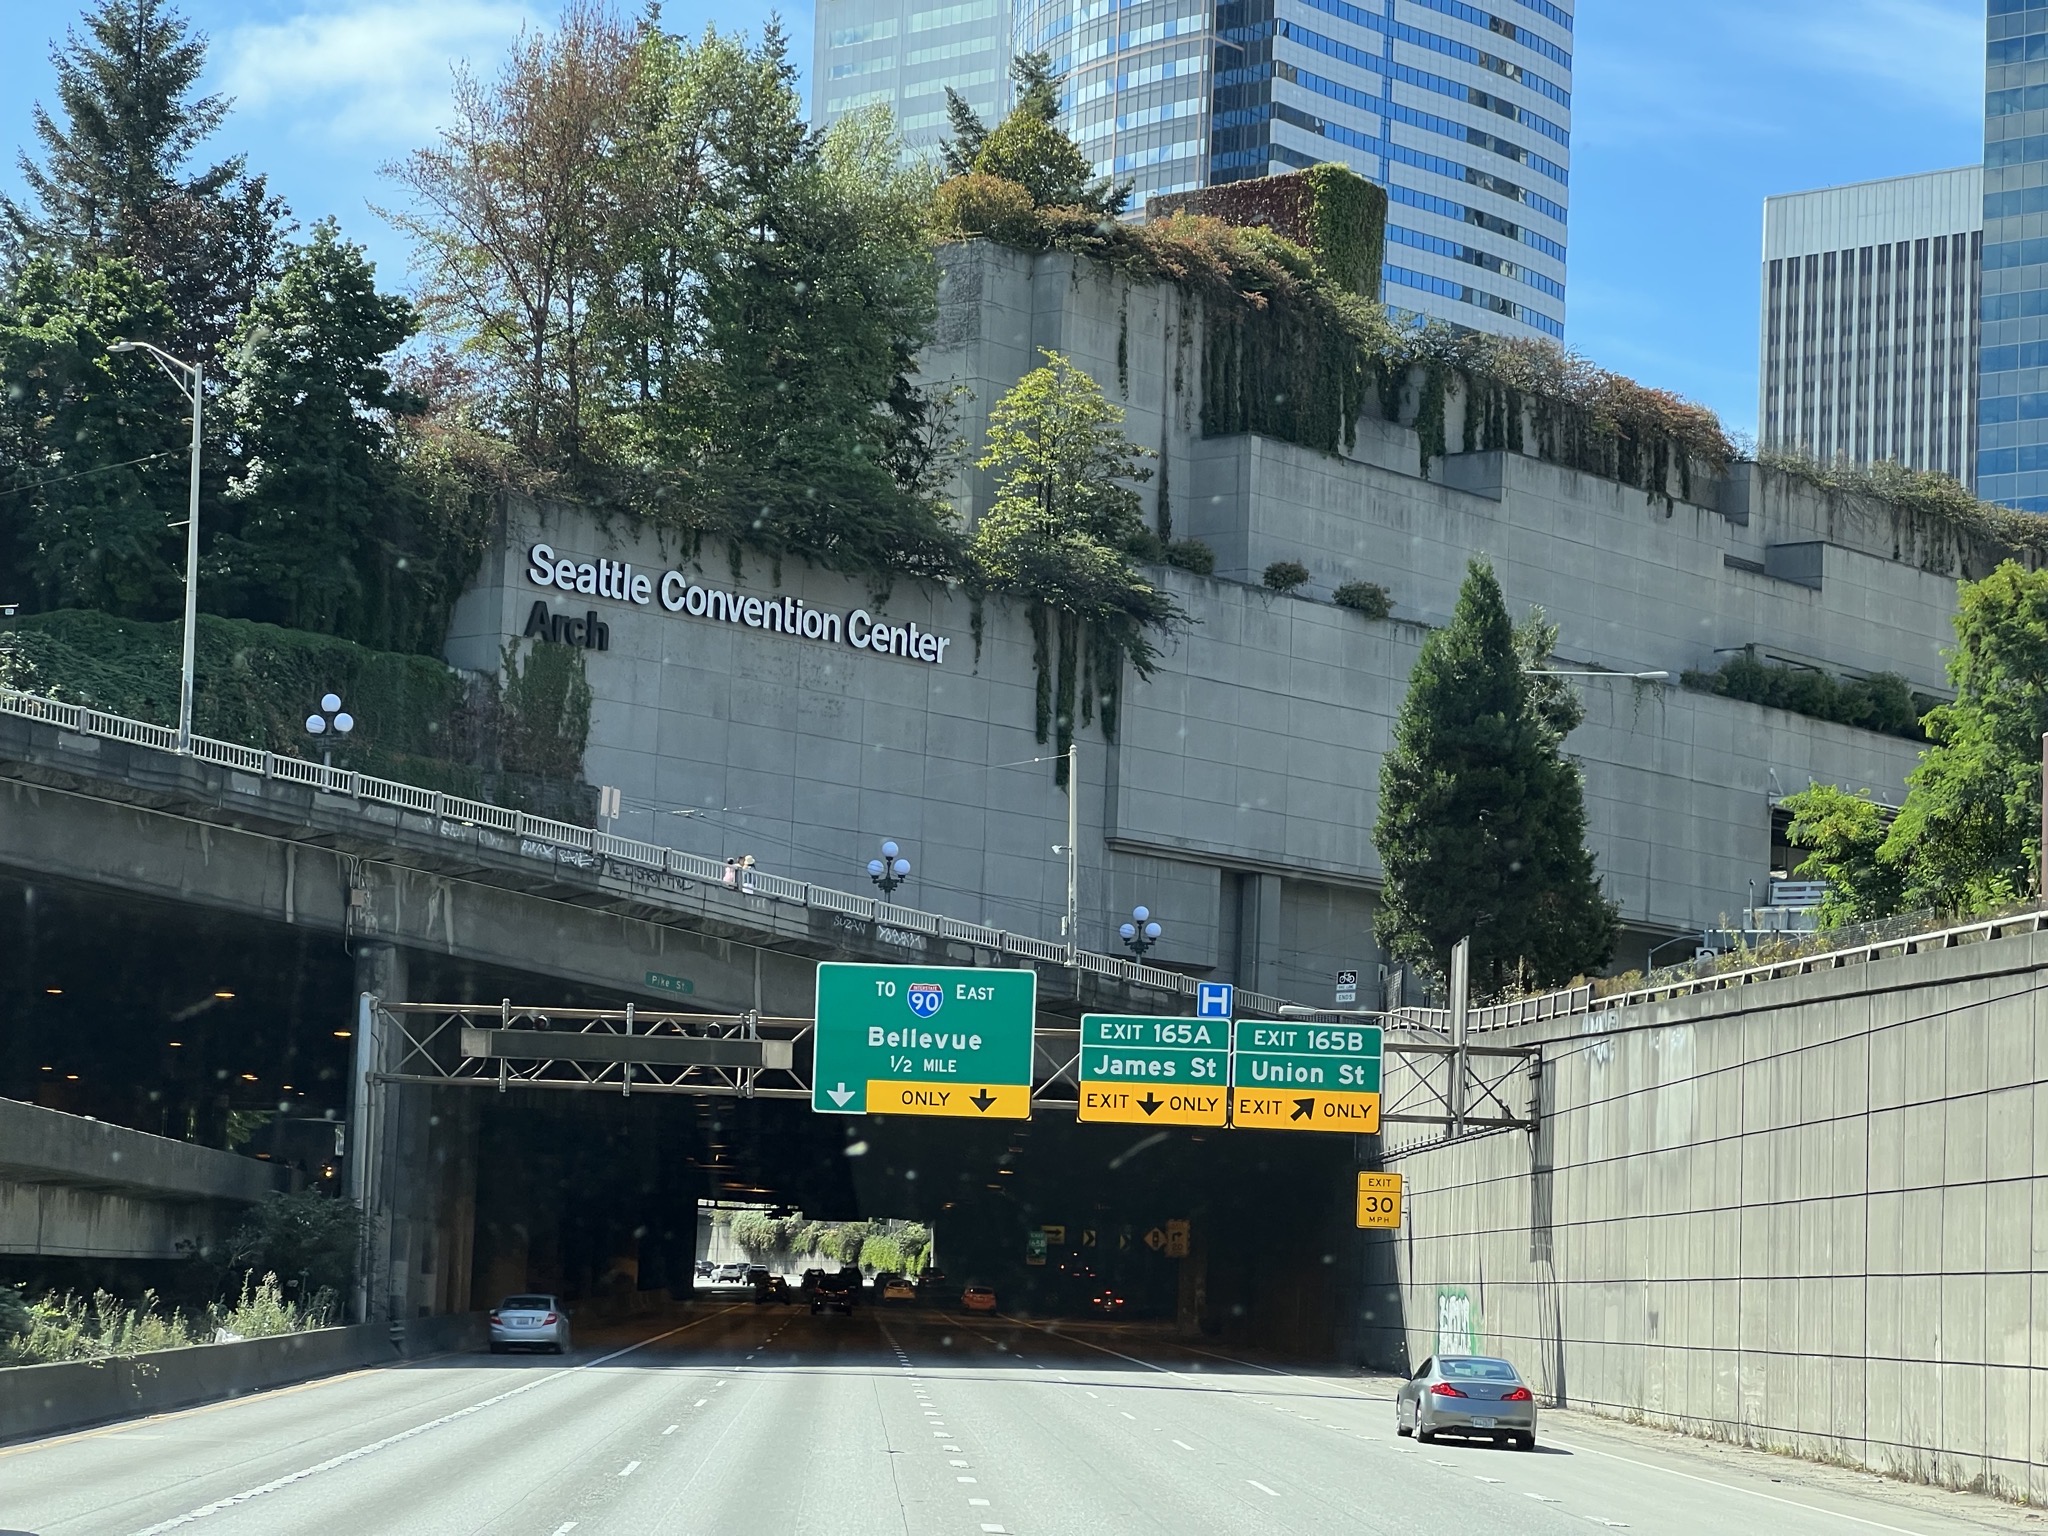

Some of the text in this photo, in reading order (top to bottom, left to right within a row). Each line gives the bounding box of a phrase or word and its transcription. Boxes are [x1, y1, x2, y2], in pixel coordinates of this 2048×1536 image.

[530, 543, 950, 664] Seattle Convention Center
[523, 600, 610, 651] Arch
[652, 975, 670, 988] Pike
[875, 981, 896, 998] TO
[911, 992, 939, 1012] 90
[1202, 987, 1228, 1015] H
[868, 1026, 982, 1051] Bellevue
[1101, 1023, 1212, 1045] EXIT 165A
[1254, 1029, 1363, 1052] EXIT 165B
[890, 1055, 957, 1073] 1/2 MILE
[1093, 1055, 1217, 1079] James St
[1251, 1060, 1365, 1086] Union St
[901, 1090, 951, 1107] ONLY
[1086, 1093, 1219, 1113] EXIT ONLY
[1239, 1099, 1373, 1119] EXIT ONLY
[1368, 1178, 1393, 1188] EXIT
[1365, 1196, 1394, 1214] 30
[1368, 1216, 1391, 1224] MPH
